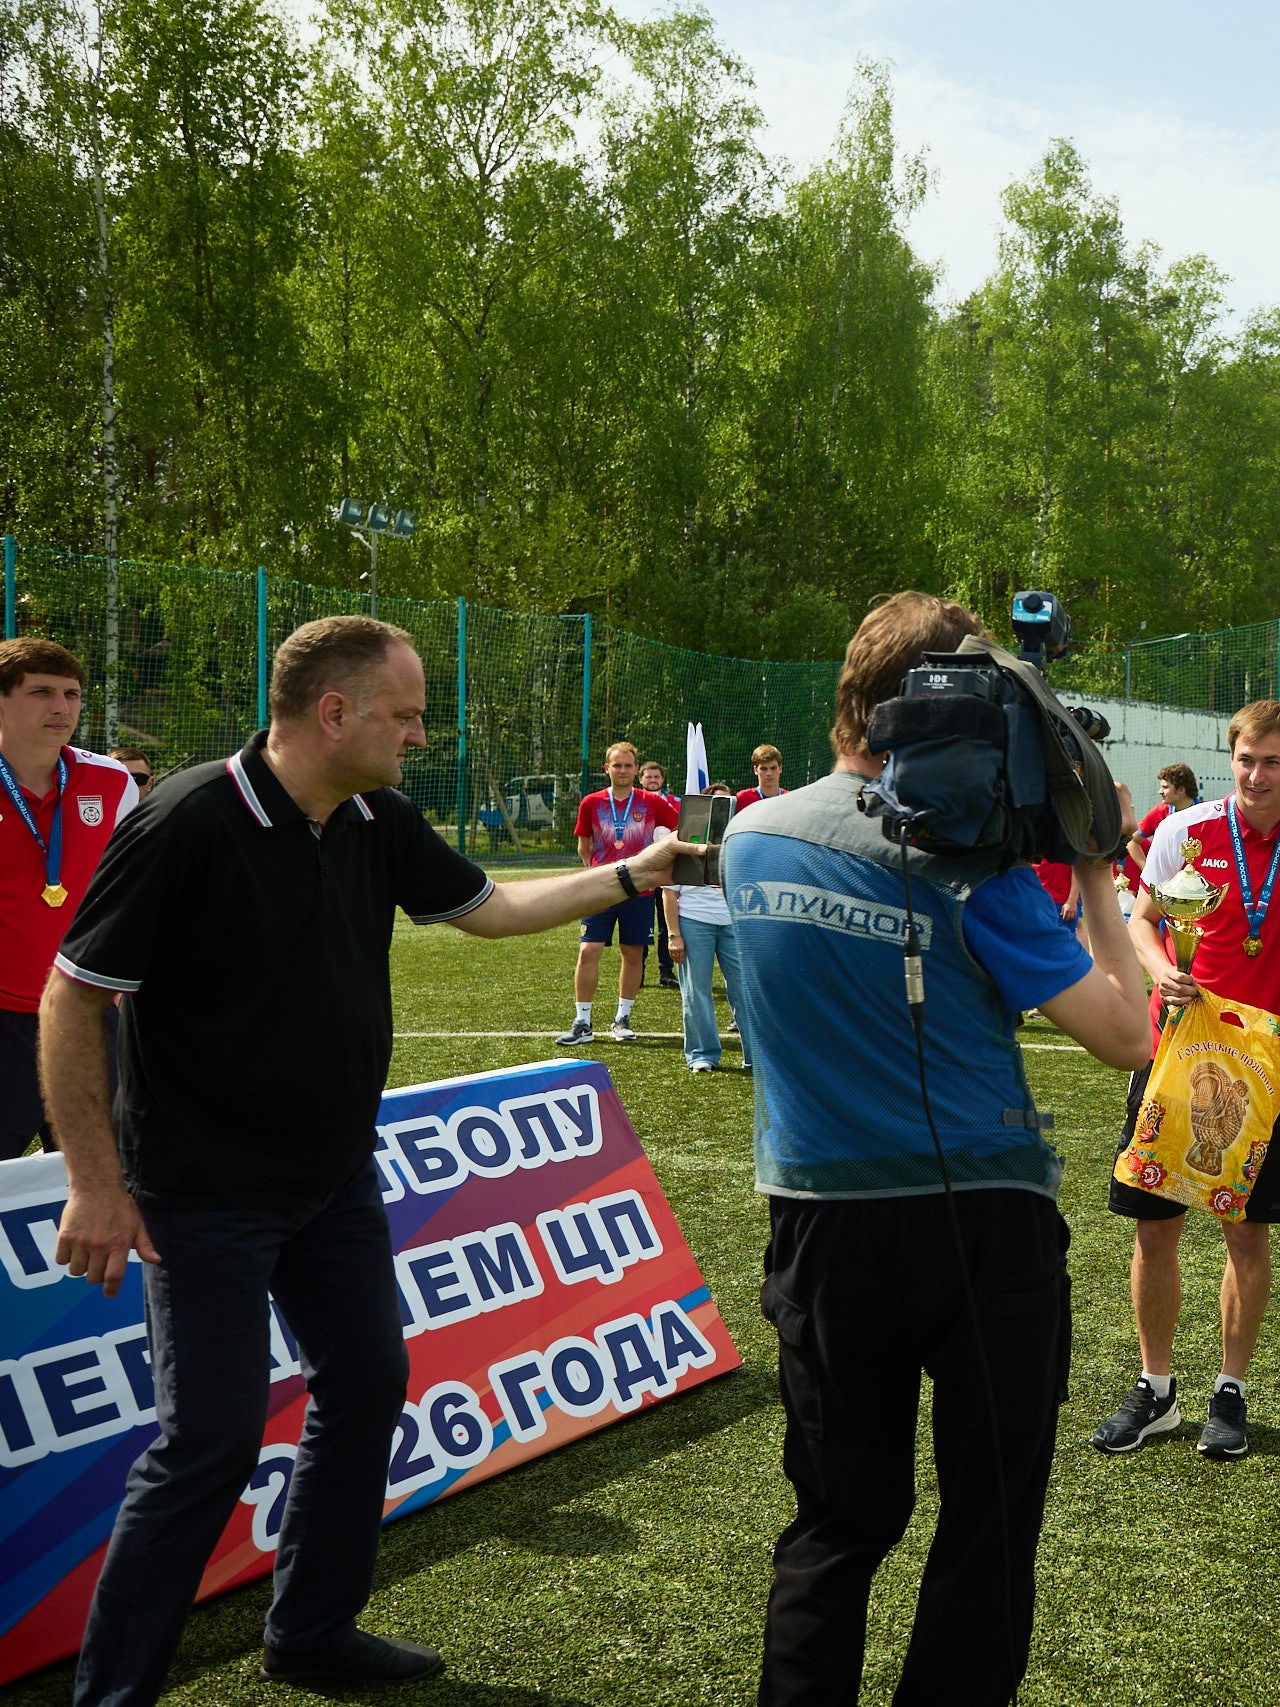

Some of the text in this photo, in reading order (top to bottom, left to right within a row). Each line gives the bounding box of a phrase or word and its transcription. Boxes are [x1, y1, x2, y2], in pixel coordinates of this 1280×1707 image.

[0, 767, 15, 790] СПОРТА
[1201, 858, 1228, 869] JAKO
[1234, 838, 1243, 861] СПОРТА
[1239, 861, 1248, 887] РОССИИ
[776, 891, 925, 938] ЛУИДОР
[546, 1199, 655, 1275] ЦП
[249, 1392, 482, 1538] 226
[498, 1310, 708, 1432] ГОДА
